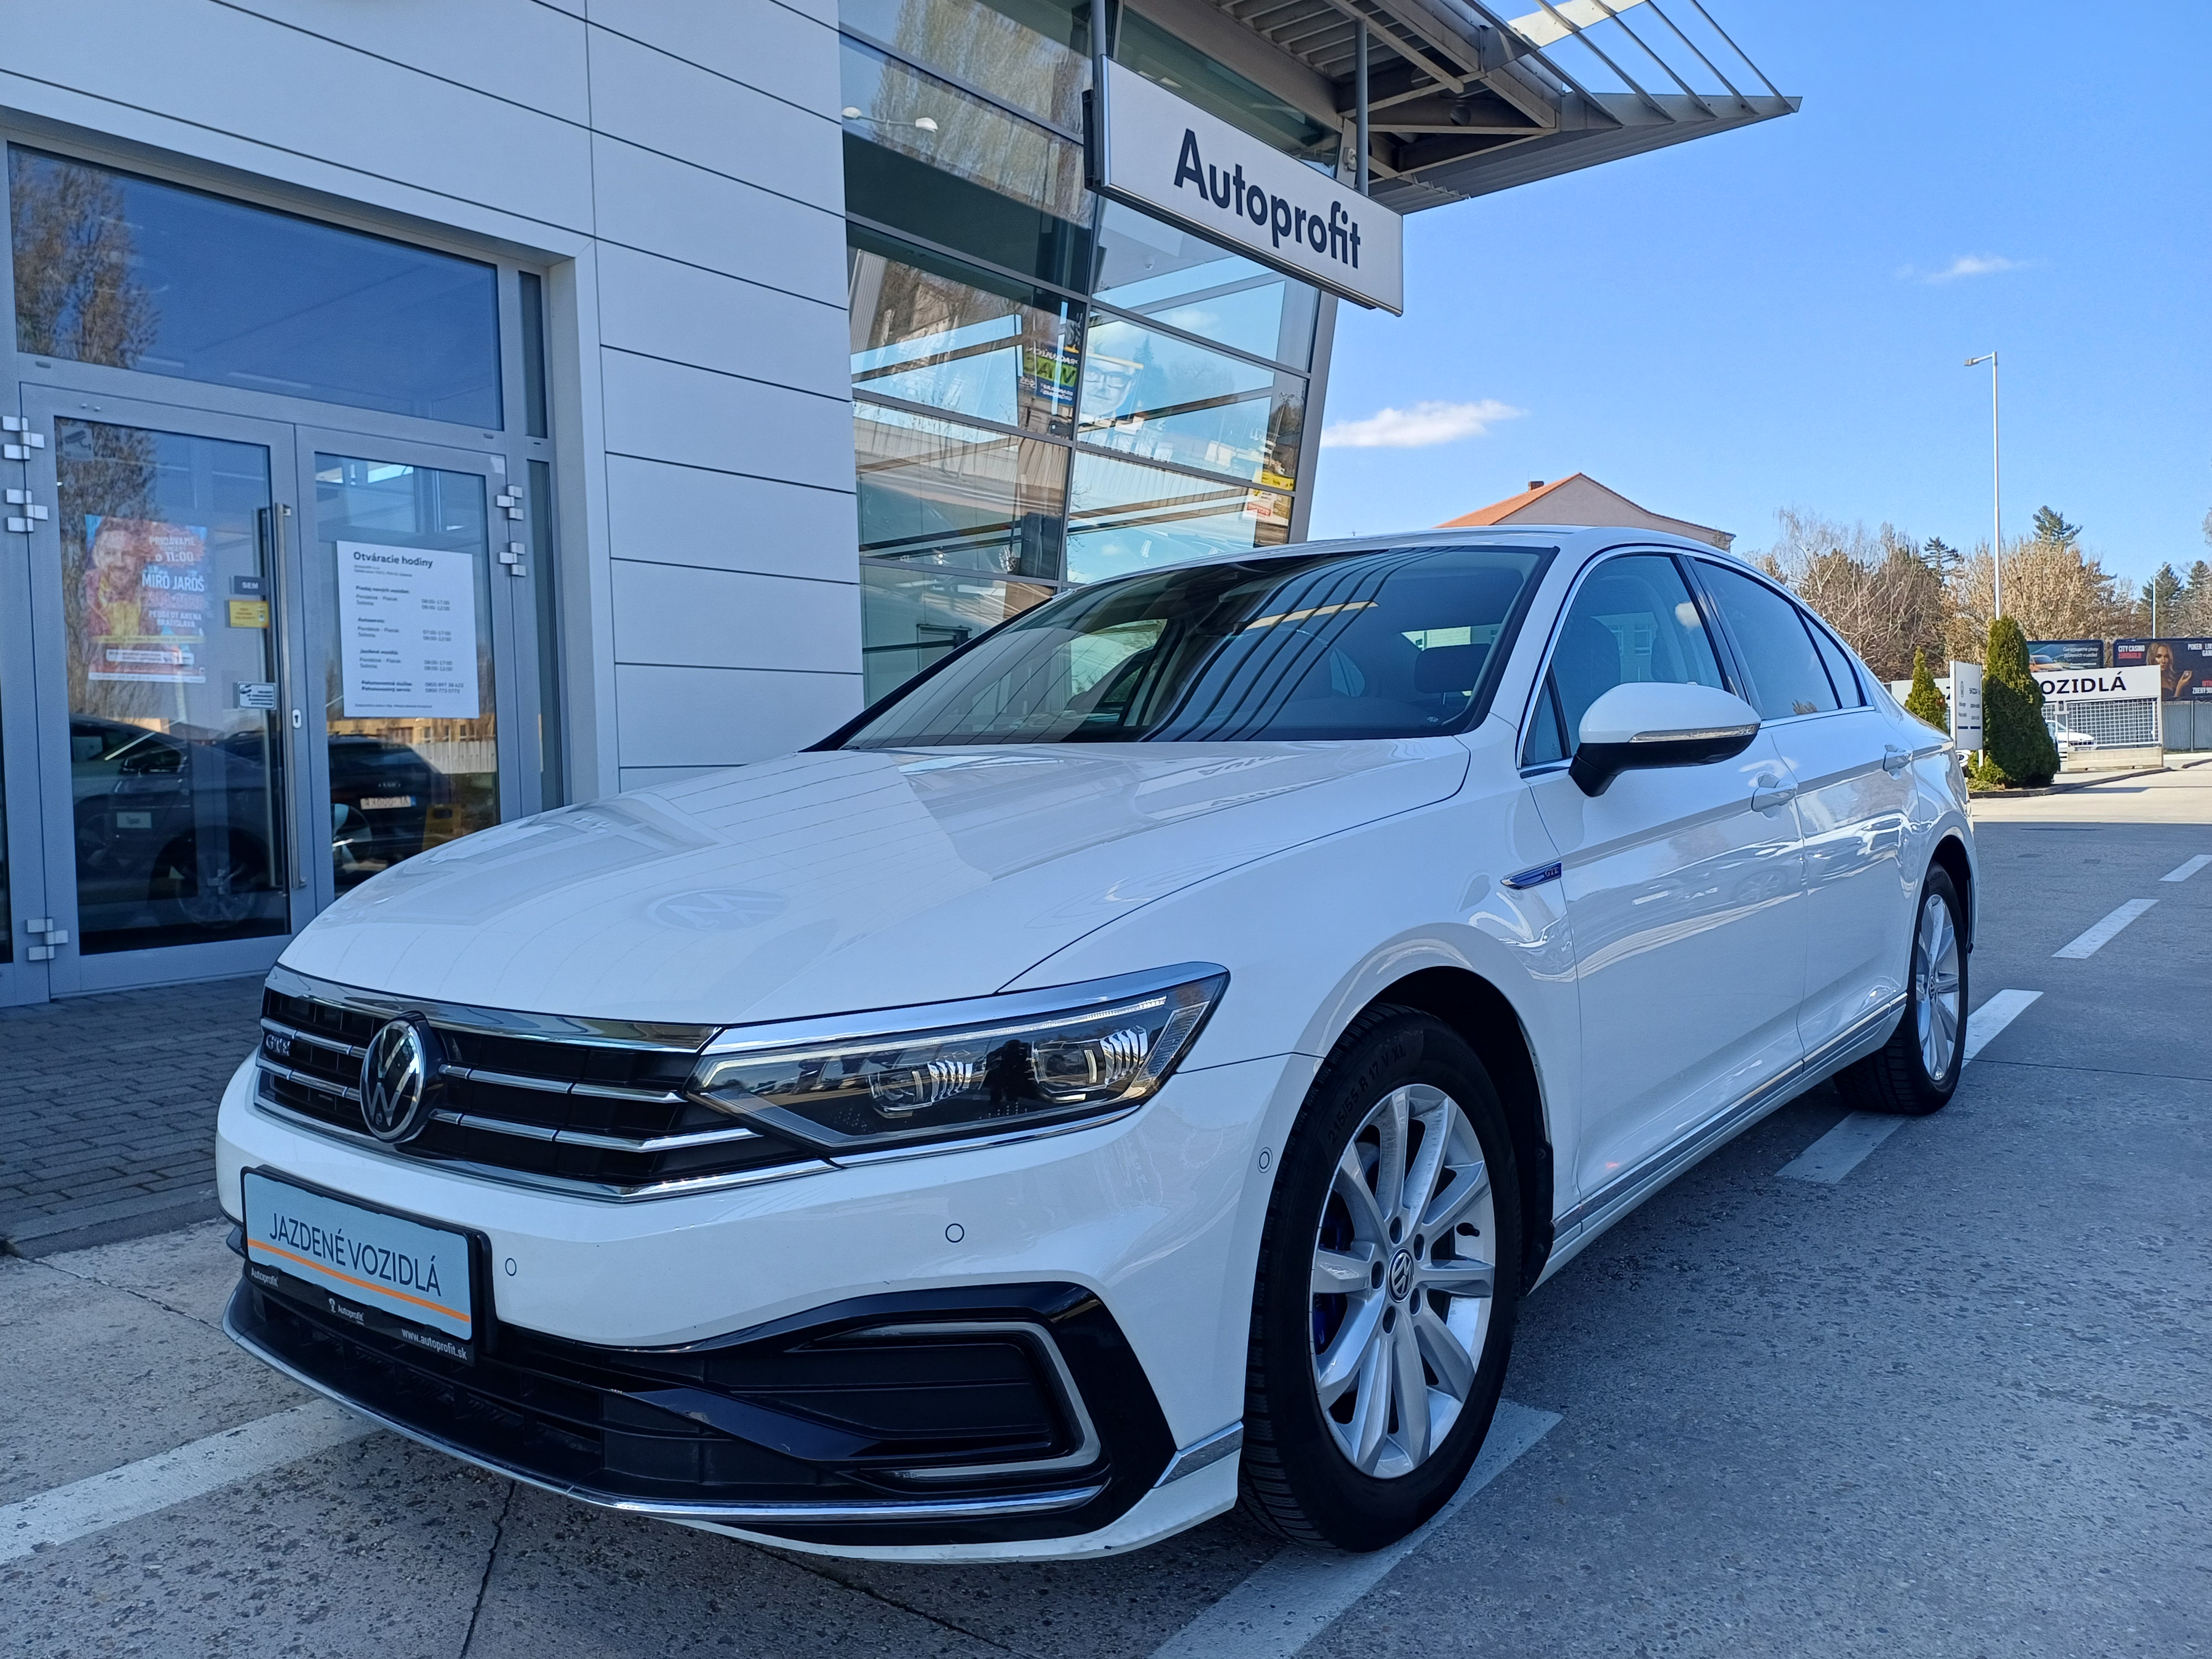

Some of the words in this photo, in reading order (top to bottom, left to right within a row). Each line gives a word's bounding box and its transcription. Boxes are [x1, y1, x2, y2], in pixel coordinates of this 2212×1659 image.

[1173, 128, 1361, 269] Autoprofit
[165, 551, 194, 562] 11:00
[353, 551, 400, 564] Otváracie
[401, 556, 433, 568] hodiny
[142, 572, 170, 589] MIRO
[172, 575, 205, 592] JAROŠ
[2041, 671, 2126, 695] OZIDLÁ
[1545, 867, 1559, 877] GTE
[1327, 1085, 1359, 1145] 215/55
[1358, 1076, 1369, 1092] R
[1368, 1060, 1380, 1081] 17
[1381, 1052, 1390, 1068] V
[1391, 1044, 1406, 1062] XL
[269, 1213, 347, 1265] JAZDENÉ
[348, 1239, 441, 1296] VOZIDLÁ
[401, 1328, 468, 1360] www.autoprofit.sk
